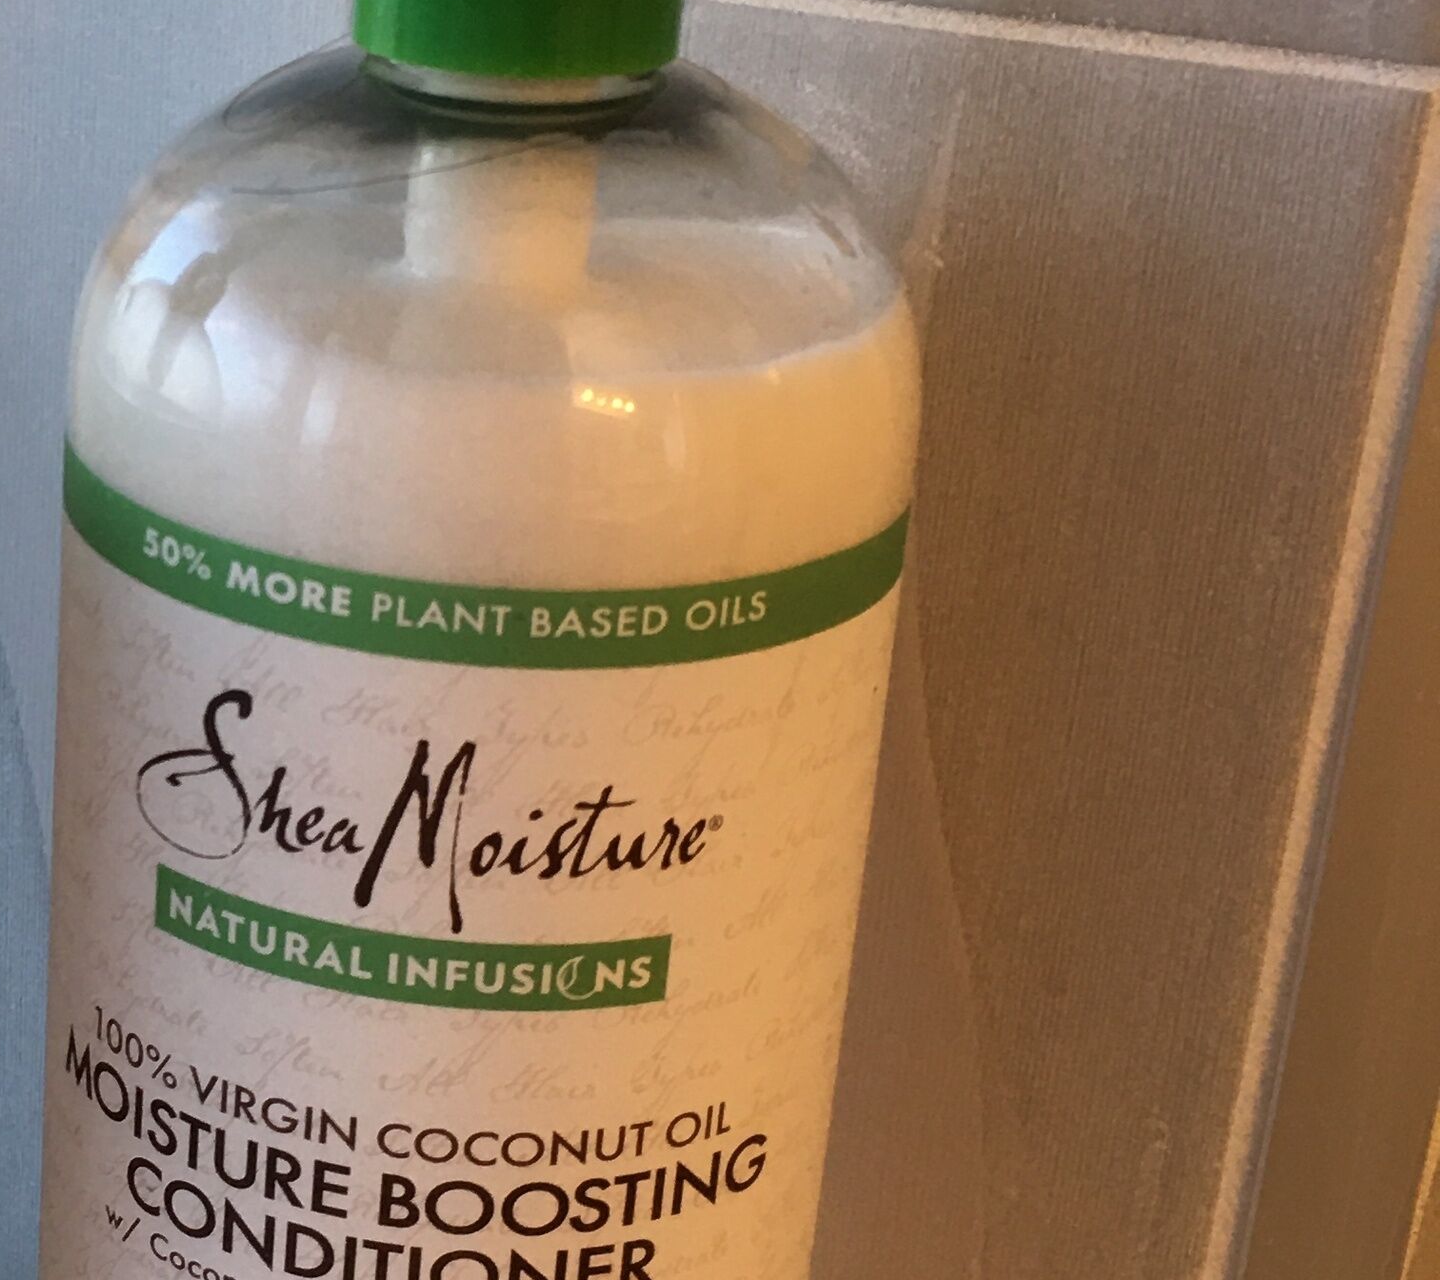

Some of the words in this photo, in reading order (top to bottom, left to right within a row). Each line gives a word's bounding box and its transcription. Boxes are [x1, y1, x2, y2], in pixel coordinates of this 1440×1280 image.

[142, 528, 212, 579] 50%
[227, 562, 352, 615] MORE
[371, 593, 512, 636] PLANT
[531, 604, 670, 639] BASED
[686, 590, 768, 629] OILS
[170, 887, 372, 980] NATURAL
[65, 1025, 349, 1218] MOISTURE
[378, 1132, 767, 1235] BOOSTING
[94, 1006, 178, 1090] 100%
[190, 1065, 358, 1150] VIRGIN
[377, 1121, 654, 1168] COCONUT
[666, 1102, 731, 1154] OIL
[105, 1205, 134, 1242] w/
